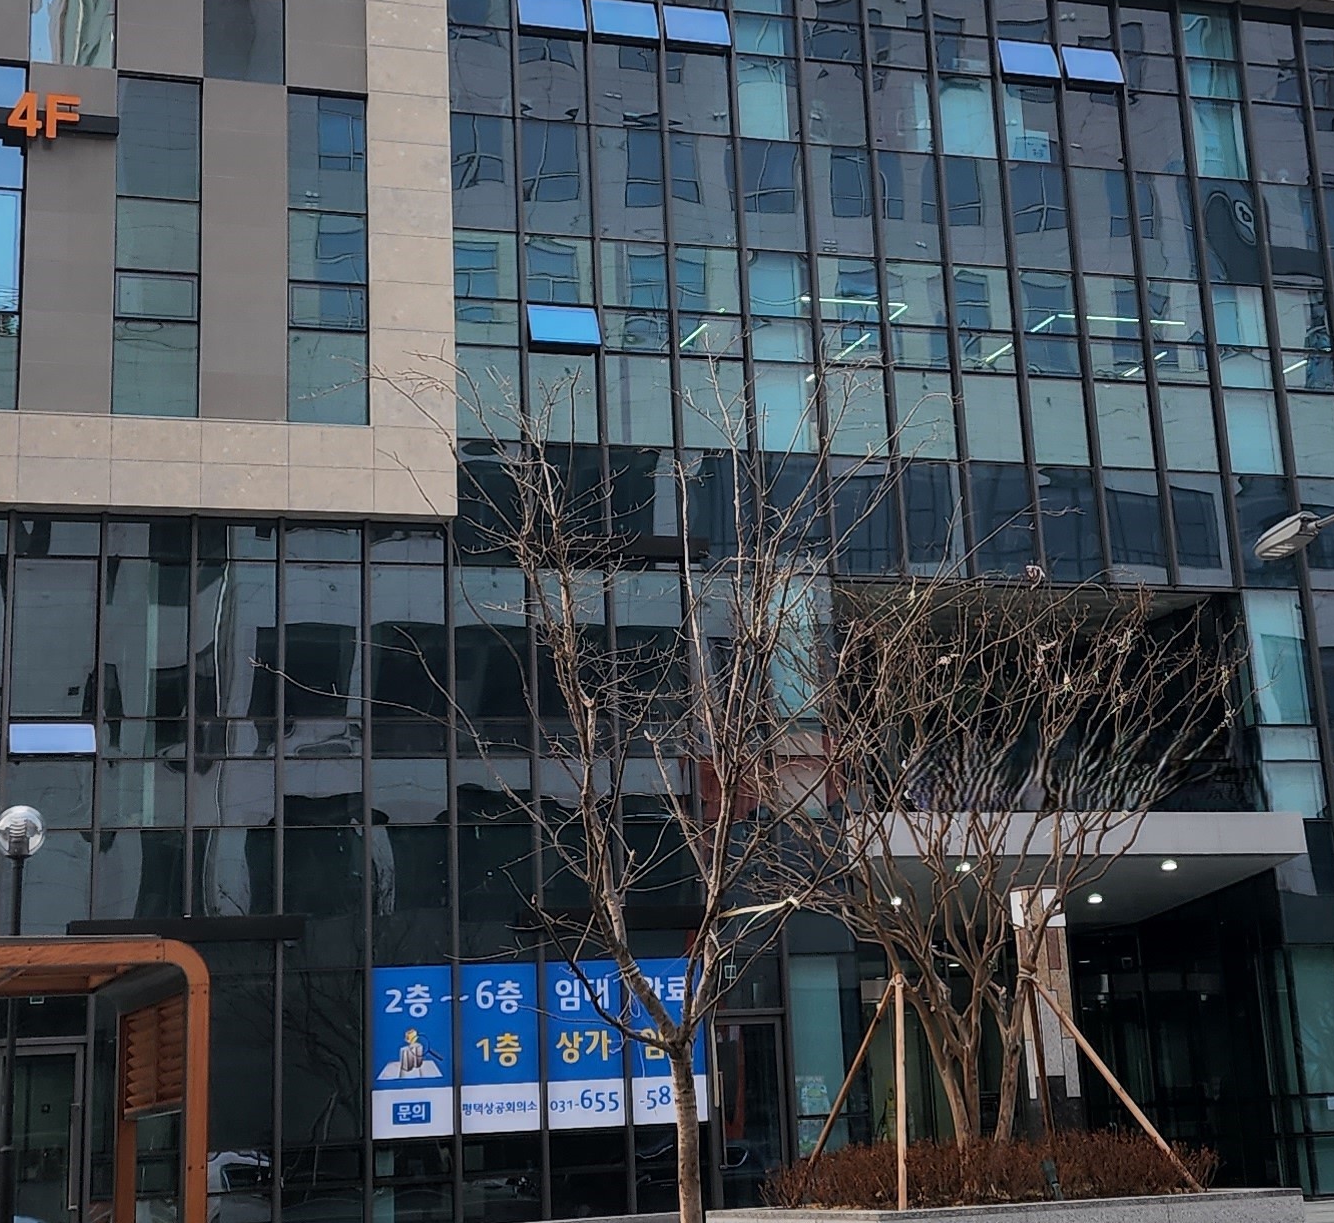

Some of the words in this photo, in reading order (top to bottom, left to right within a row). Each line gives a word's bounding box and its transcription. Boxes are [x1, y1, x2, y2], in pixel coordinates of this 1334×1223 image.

[5, 91, 83, 141] 4F
[385, 983, 433, 1018] 2층
[475, 980, 524, 1014] 6층
[555, 978, 610, 1011] 임대
[475, 1033, 523, 1067] 1층
[556, 1030, 612, 1064] 상가
[396, 1102, 427, 1124] 문의
[462, 1100, 538, 1116] 평택상공회의소
